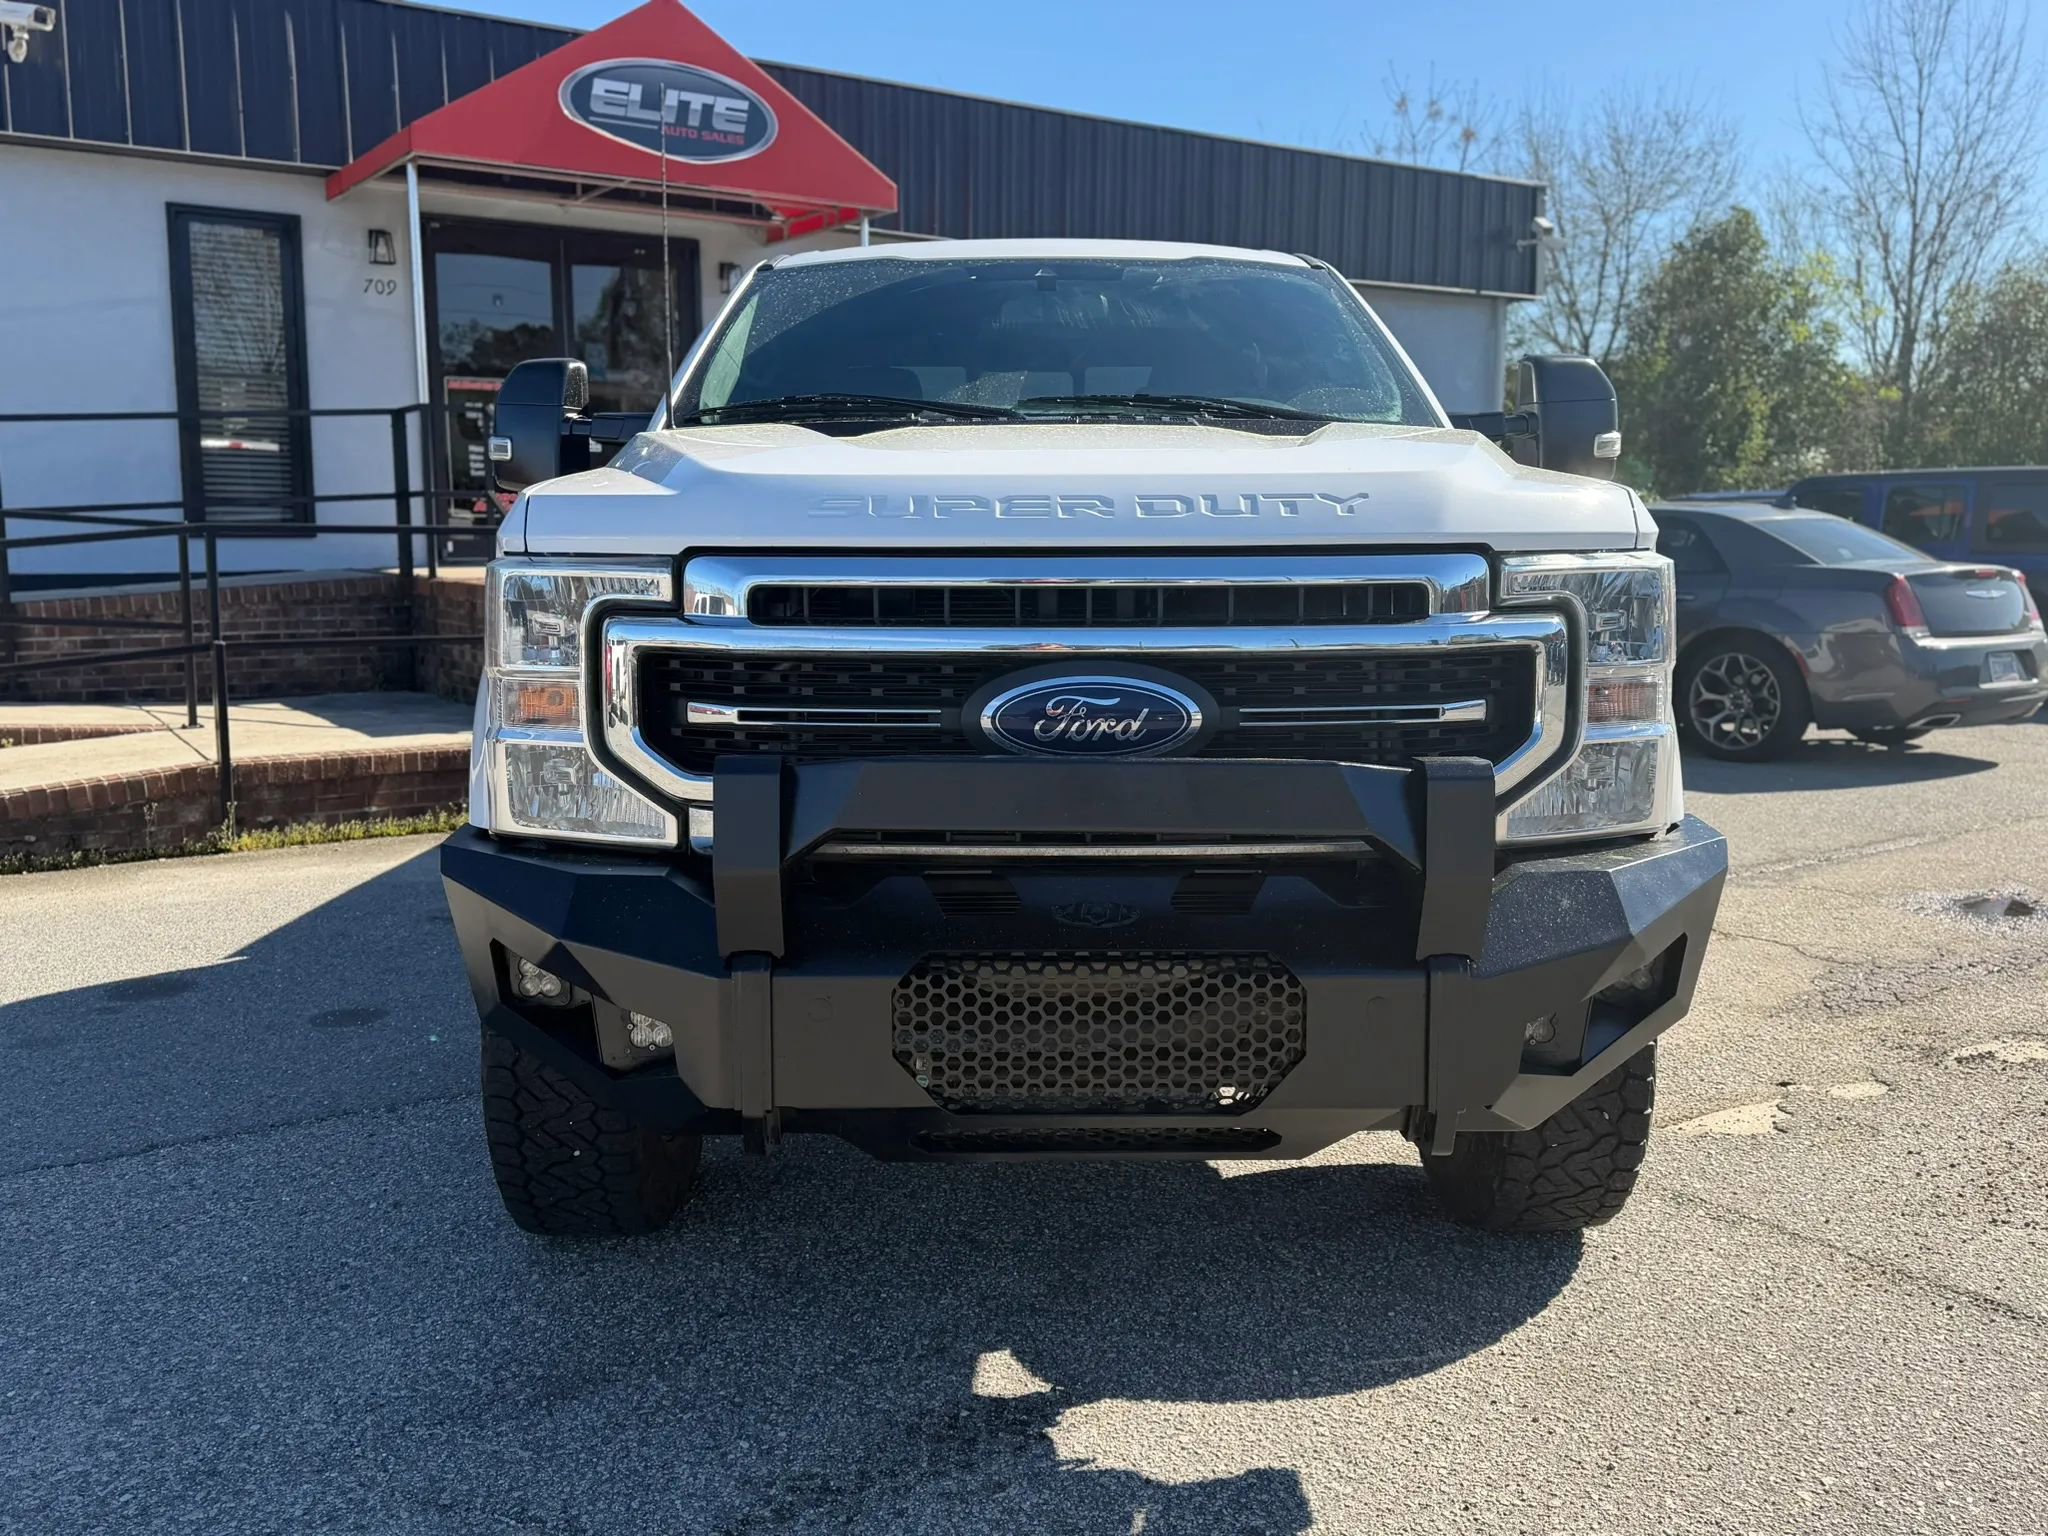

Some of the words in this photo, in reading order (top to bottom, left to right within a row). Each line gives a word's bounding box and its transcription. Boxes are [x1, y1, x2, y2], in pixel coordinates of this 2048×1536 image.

[590, 78, 750, 133] ELITE
[662, 125, 698, 139] AUTO
[701, 130, 745, 145] SALES
[364, 278, 397, 296] 709
[808, 494, 1115, 519] SUPER
[1135, 492, 1370, 518] DUTY
[1034, 695, 1149, 742] Ford
